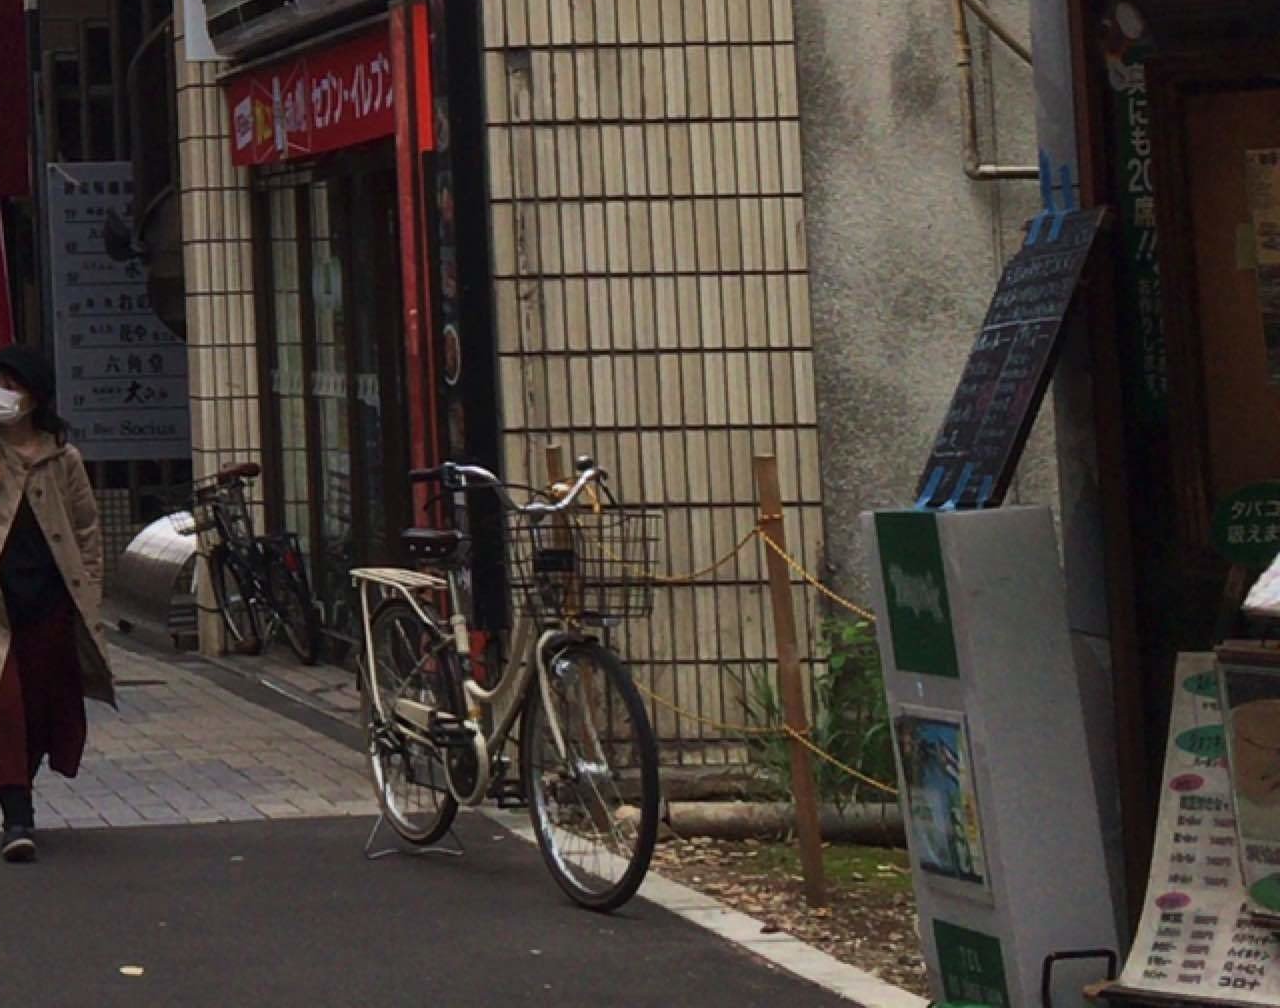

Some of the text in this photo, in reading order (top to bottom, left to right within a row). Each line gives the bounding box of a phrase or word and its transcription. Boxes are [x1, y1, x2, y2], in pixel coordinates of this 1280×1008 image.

[119, 419, 178, 435] Socius
[1231, 499, 1280, 521] タバコ
[1218, 975, 1261, 991] コロナ
